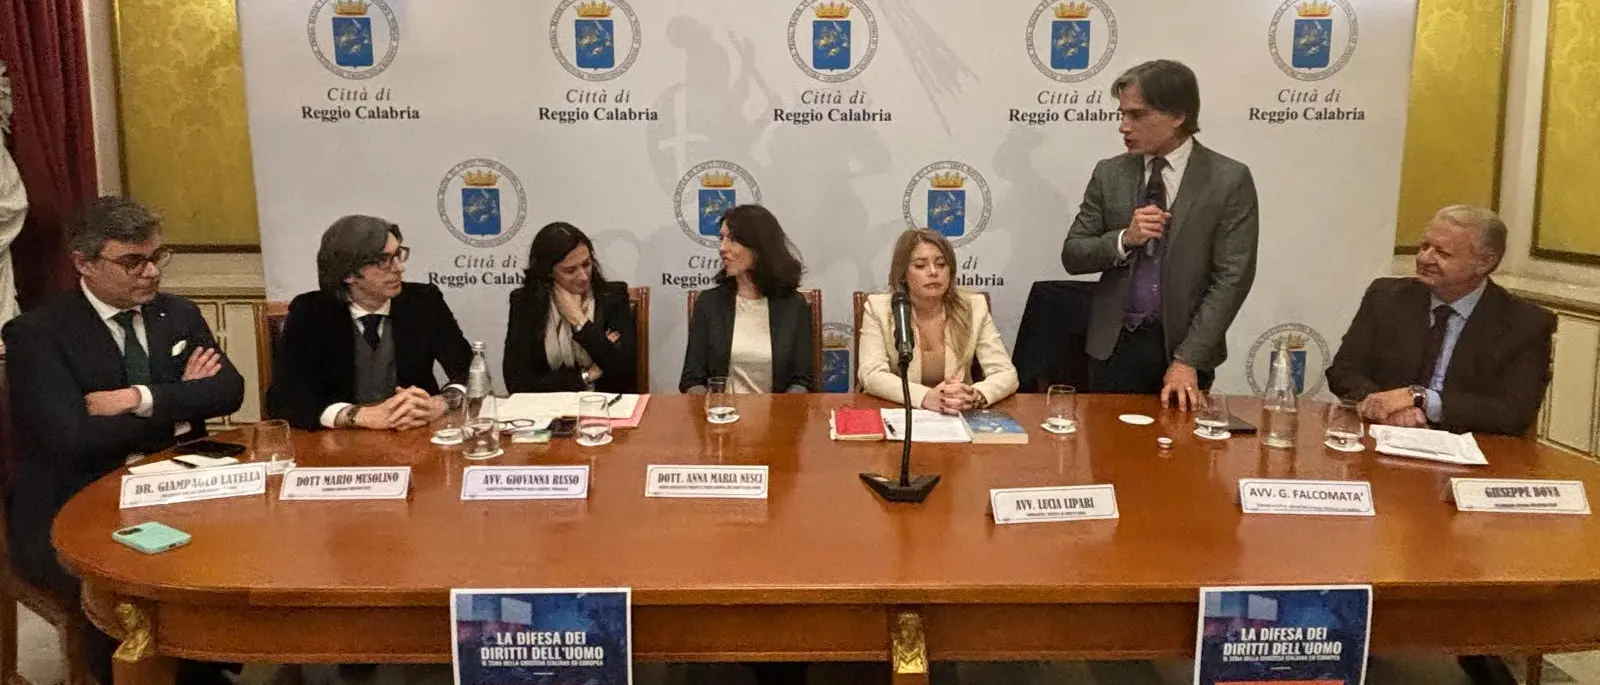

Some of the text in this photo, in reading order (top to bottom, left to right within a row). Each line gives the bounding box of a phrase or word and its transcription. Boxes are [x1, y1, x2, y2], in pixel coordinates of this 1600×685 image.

[327, 87, 391, 102] Città di
[566, 89, 630, 103] Città di
[801, 90, 865, 104] Città di
[1037, 90, 1102, 104] Città di
[1278, 88, 1341, 103] Città di
[301, 106, 420, 122] Reggio Calabria
[538, 107, 658, 123] Reggio Calabria
[773, 108, 892, 124] Reggio Calabria
[1009, 108, 1123, 125] Reggio Calabri
[1249, 107, 1365, 123] Reggio Calabria
[454, 253, 517, 268] Città di
[962, 256, 978, 270] di
[428, 271, 525, 287] Reggio Calab
[661, 273, 710, 288] Reggio
[956, 274, 1004, 286] alabria
[135, 484, 154, 495] DR.
[221, 471, 261, 485] LATELLA
[296, 472, 399, 487] DOTT MARIO MUSOLINO
[483, 474, 579, 485] AVV. GIOVANNA RUSSO
[658, 473, 763, 484] DOTT. ANNA MARIA NESCI
[1250, 488, 1276, 498] AVV.
[1279, 489, 1290, 498] G.
[1485, 486, 1560, 498] GIUSEPPE BOVA
[1015, 497, 1094, 511] AVV. LUCIA LIPARI
[496, 631, 586, 645] LA DIFESA DEI
[1241, 627, 1327, 641] LA DIFESA DEI
[480, 646, 604, 660] DIRITTI DELL'UOMO
[1223, 641, 1342, 656] DIRITTI DELL'UOMO
